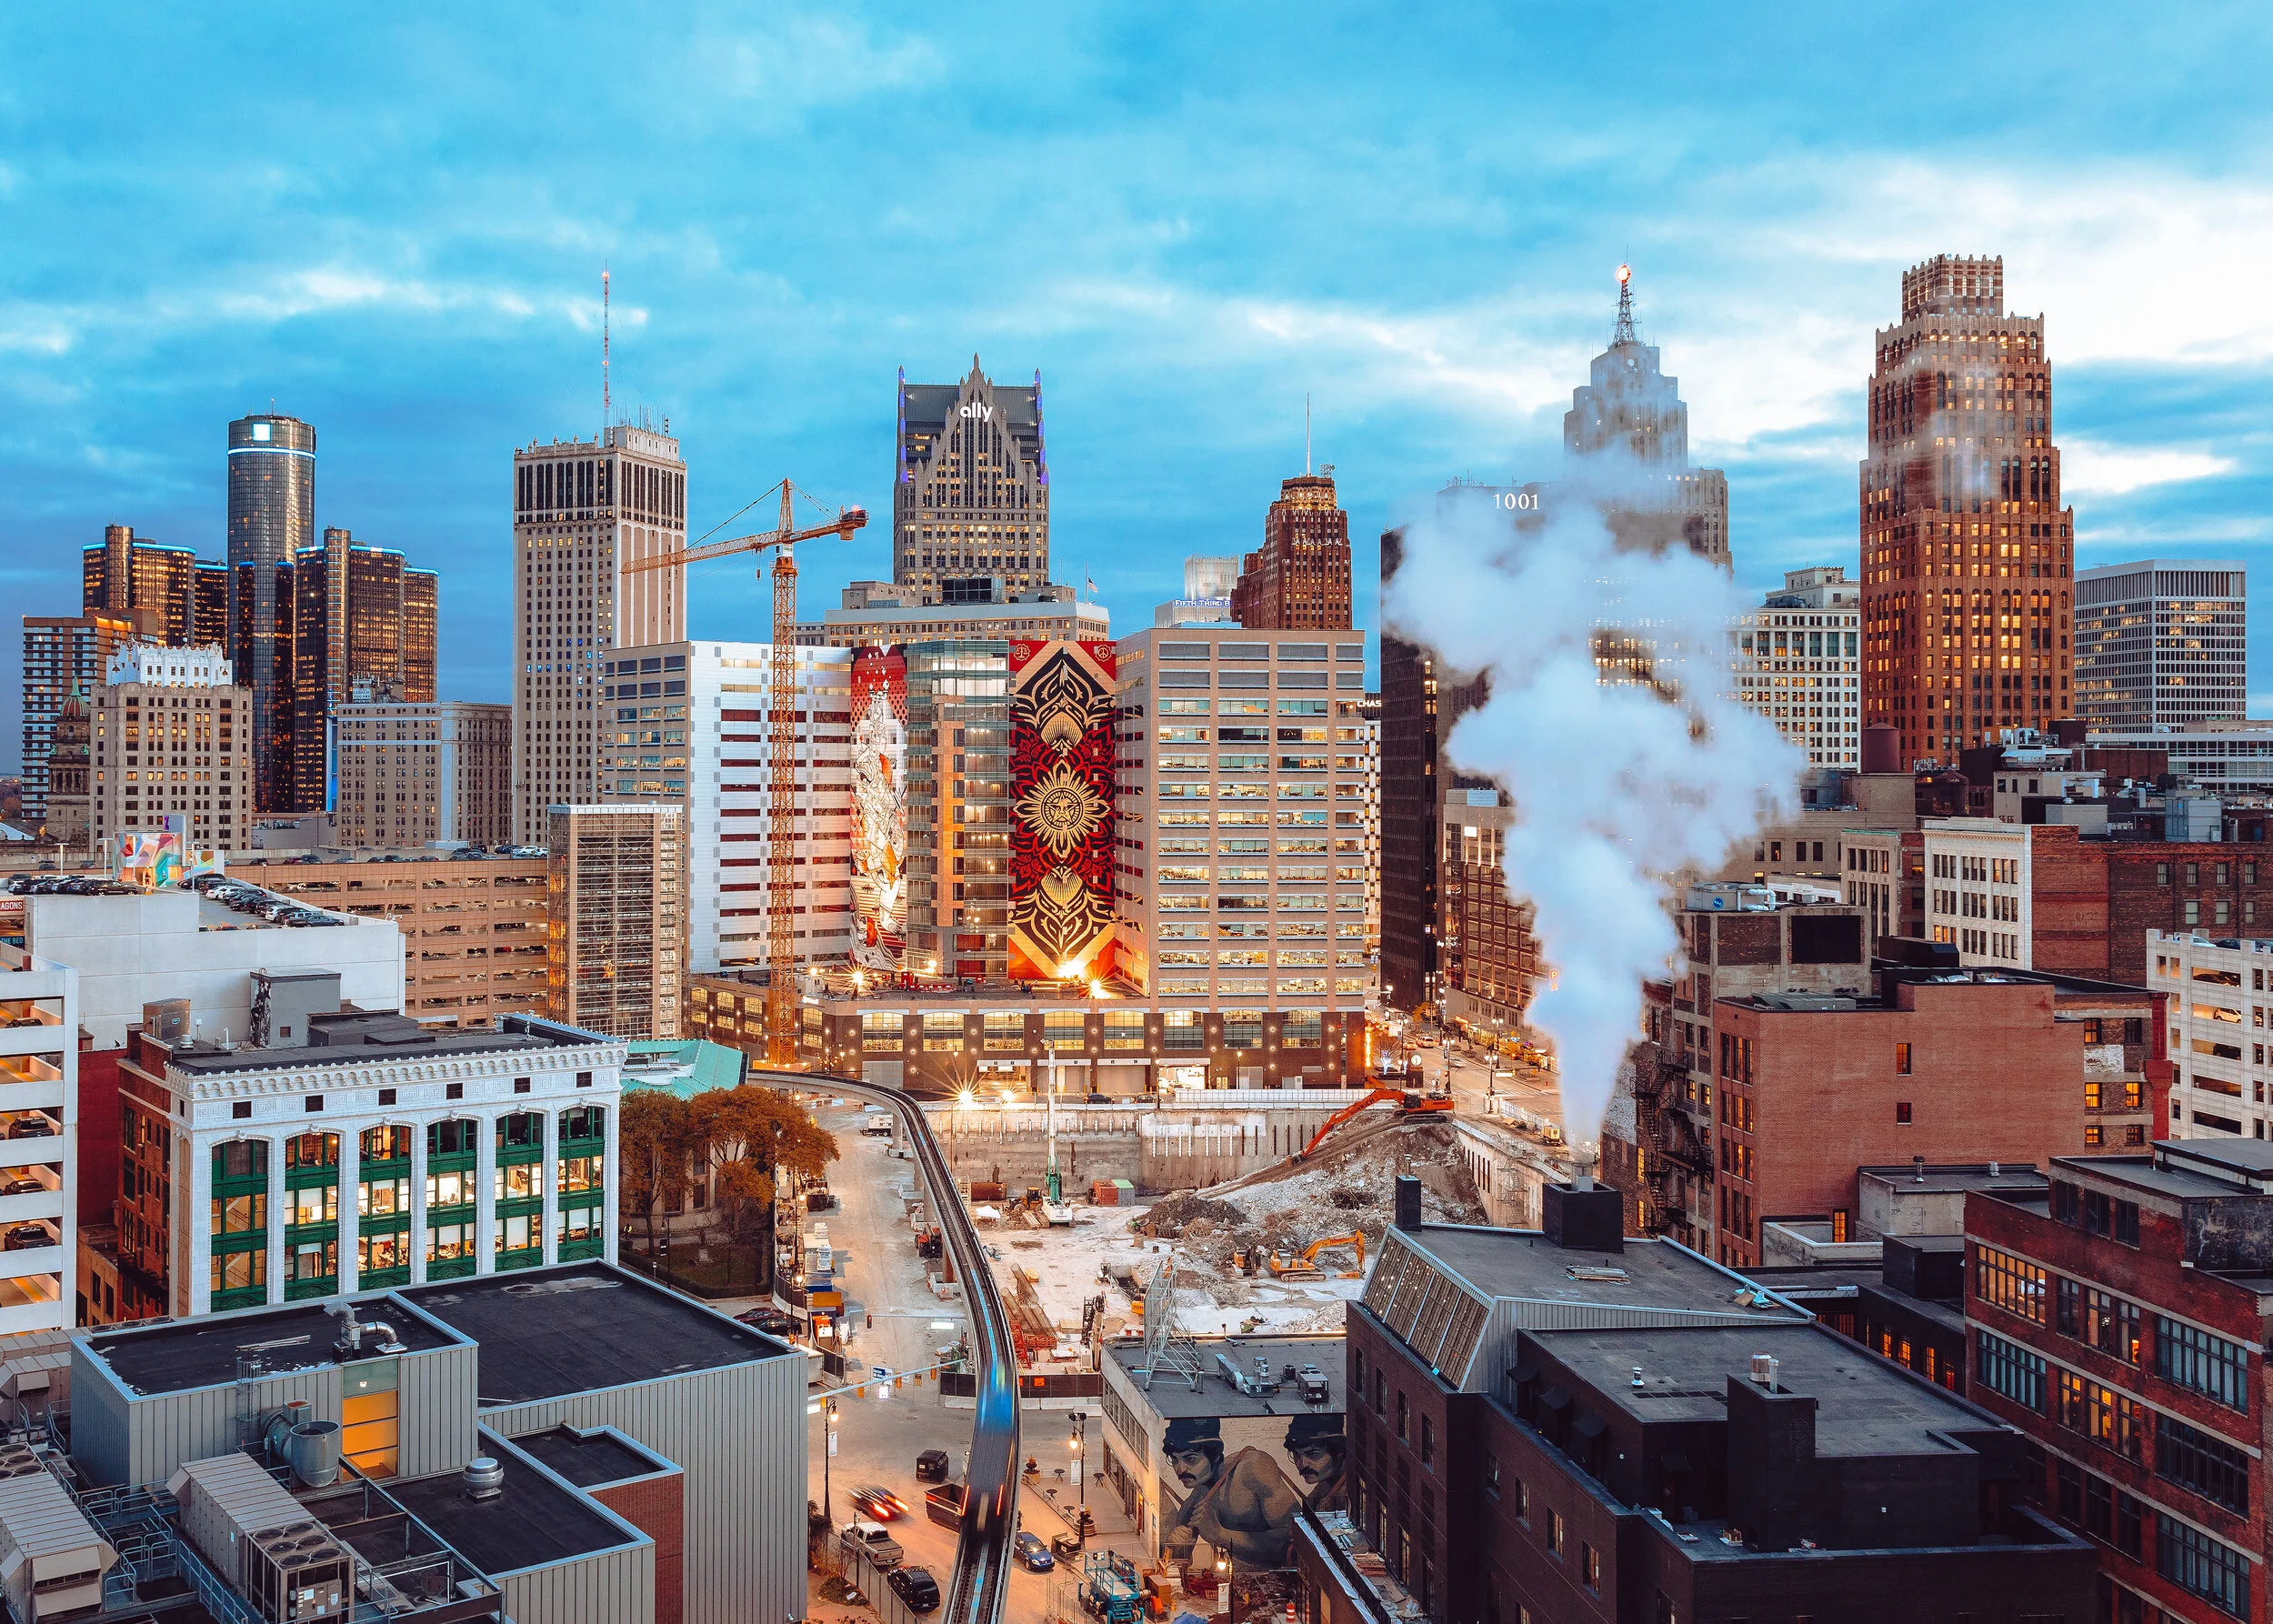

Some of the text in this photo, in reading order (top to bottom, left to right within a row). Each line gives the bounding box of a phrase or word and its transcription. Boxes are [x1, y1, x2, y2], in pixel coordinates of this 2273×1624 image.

[960, 402, 993, 423] ally
[1492, 493, 1539, 510] 1001
[1198, 598, 1222, 606] THIRD
[1, 901, 23, 910] AGONS
